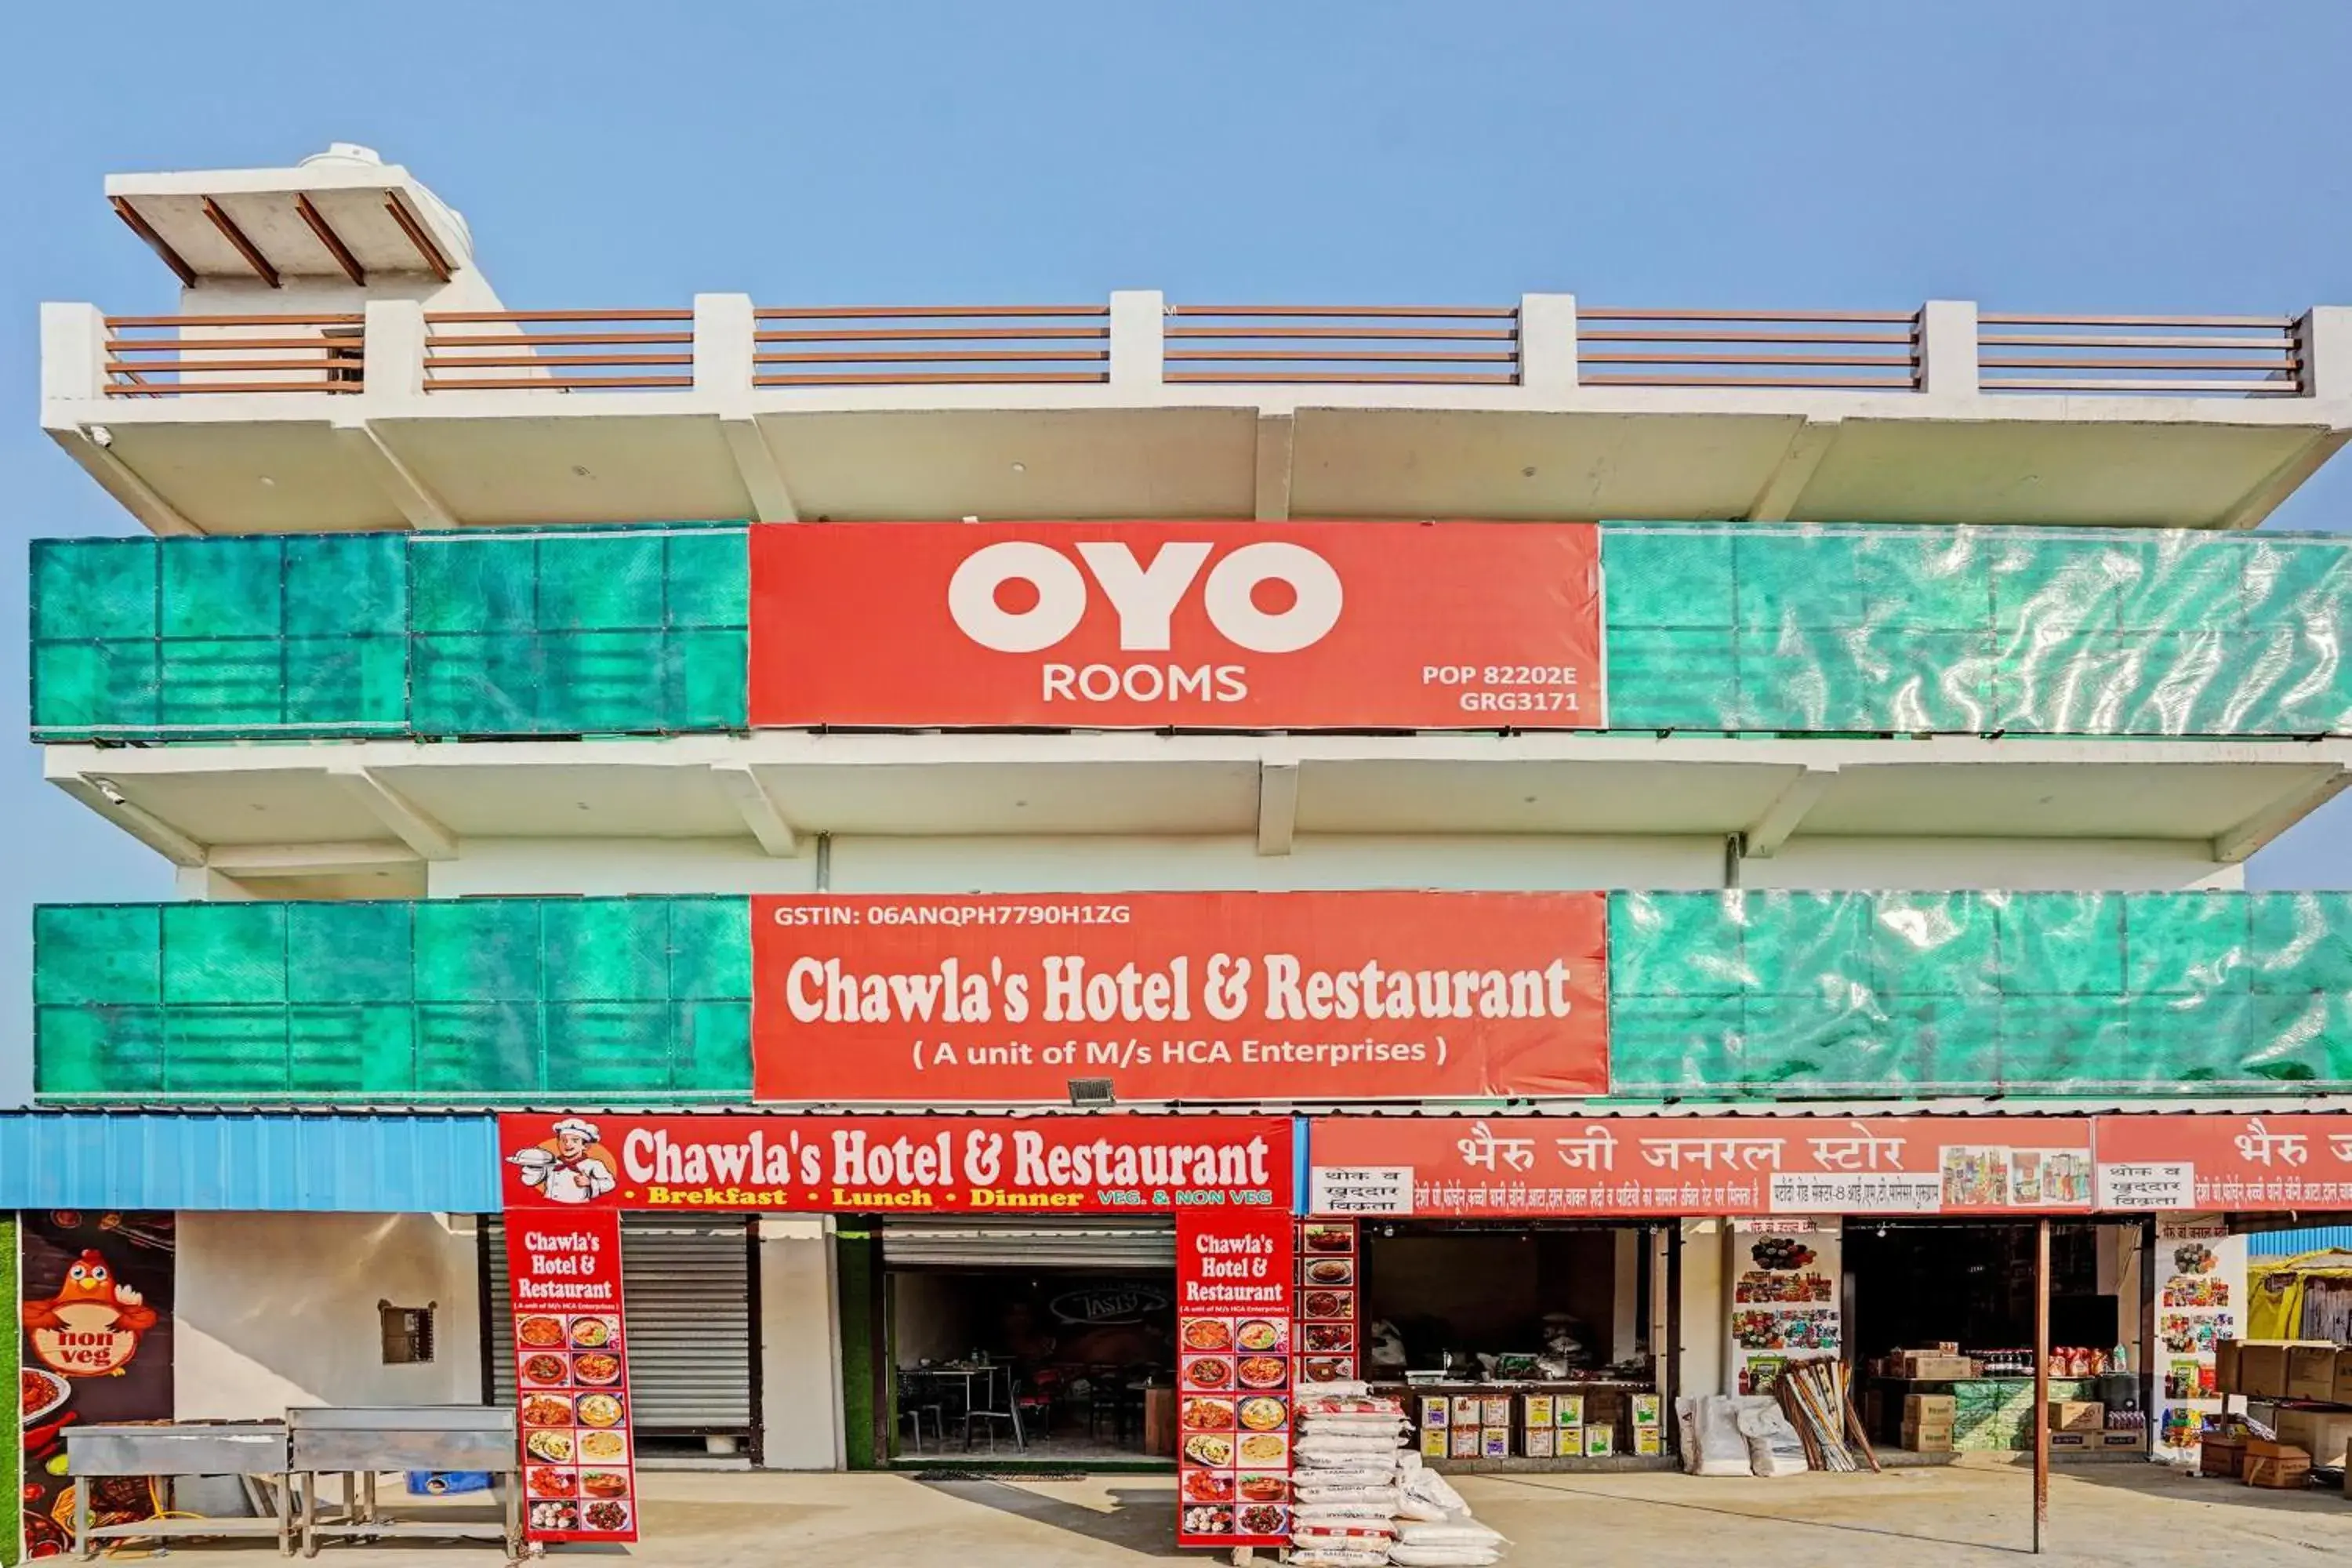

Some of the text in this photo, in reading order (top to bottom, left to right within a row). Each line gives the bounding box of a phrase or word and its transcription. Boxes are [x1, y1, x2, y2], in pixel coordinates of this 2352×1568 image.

[948, 541, 1343, 653] OYO
[1044, 664, 1247, 702] ROOMS
[1423, 666, 1577, 684] POP 82202E
[1460, 692, 1579, 710] GRG3171
[775, 906, 1130, 927] GSTIN: 06ANQPH7790H1ZG
[786, 953, 1571, 1022] Chawla's Hotel & Restaurant
[968, 1041, 1032, 1065] unit
[1043, 1040, 1076, 1064] of
[1087, 1039, 1152, 1069] M/s
[1163, 1040, 1232, 1063] HCA
[1243, 1038, 1425, 1067] Enterprises
[1555, 1125, 1618, 1171] जी
[1639, 1138, 1787, 1171] जनरल
[1806, 1121, 1907, 1171] स्टोर
[623, 1128, 1269, 1186] Chawla's Hotel & Restaurant
[647, 1186, 1273, 1207] Brekfast Lunch Dinner VEG. & NON VEG
[524, 1232, 600, 1252] Chawla's
[1196, 1233, 1273, 1254] Chawla's
[532, 1254, 595, 1275] Hotel &
[1202, 1257, 1268, 1278] Hotel &
[518, 1278, 612, 1299] Restaurant
[1186, 1281, 1283, 1301] Restaurant
[58, 1332, 114, 1346] non
[60, 1348, 111, 1367] veg
